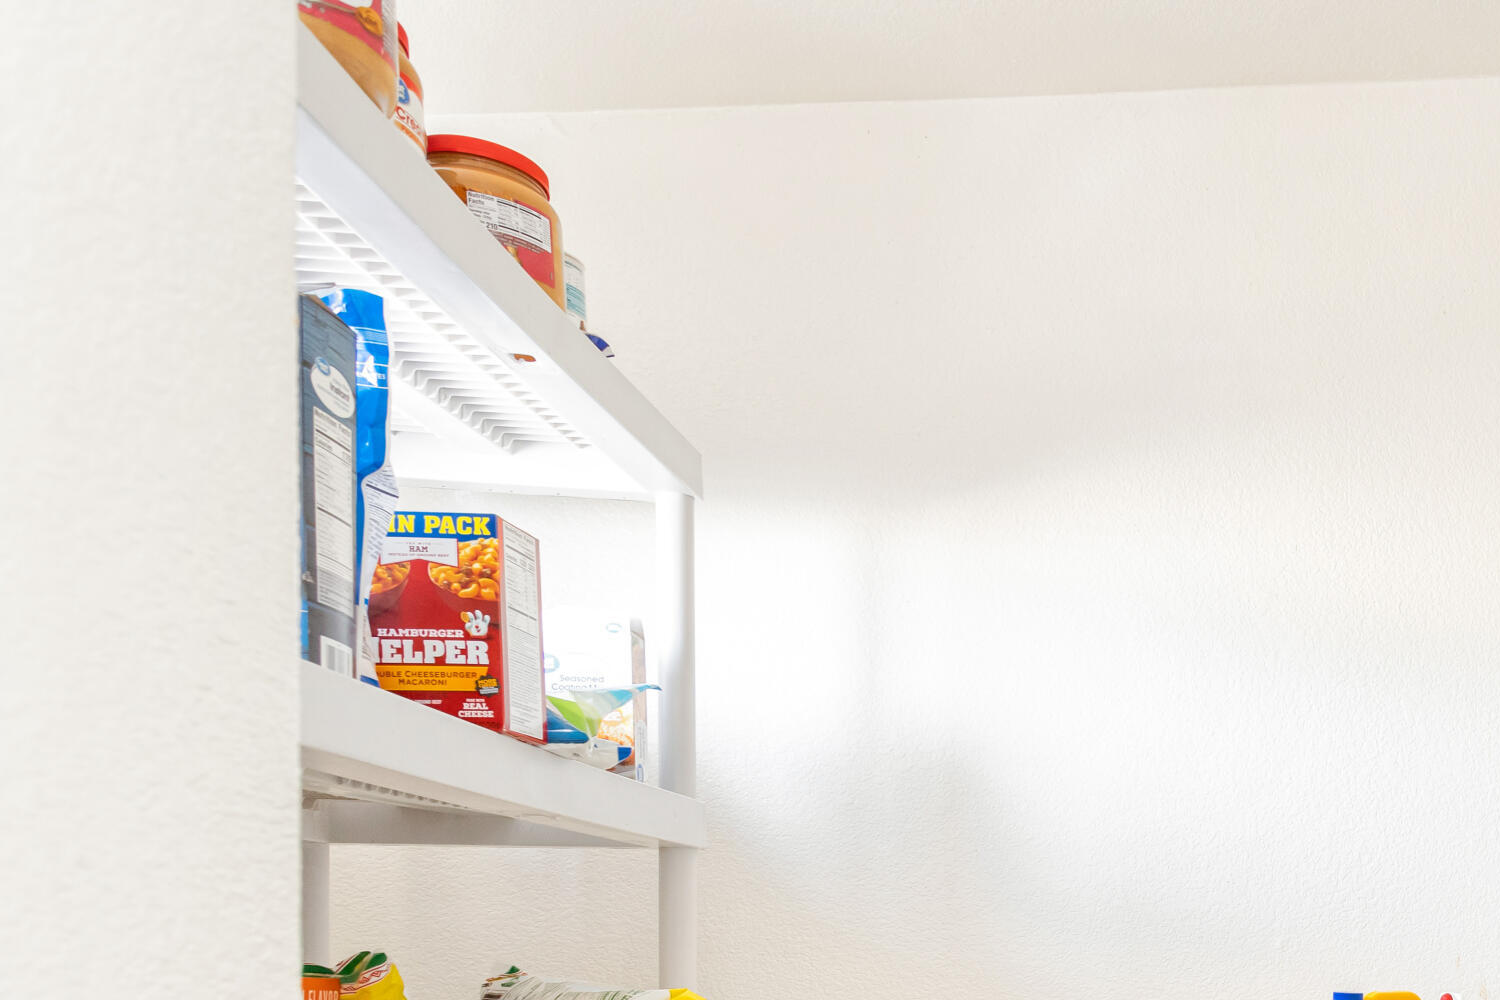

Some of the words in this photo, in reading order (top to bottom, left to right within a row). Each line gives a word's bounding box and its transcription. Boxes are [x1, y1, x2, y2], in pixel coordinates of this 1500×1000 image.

[423, 514, 491, 536] PACK
[408, 545, 429, 553] HAM
[377, 628, 465, 638] HAMBURGER
[404, 670, 478, 679] CHEESEBURGER
[559, 674, 605, 684] Seasoned
[462, 702, 489, 710] REAL
[457, 710, 495, 718] CHEESE
